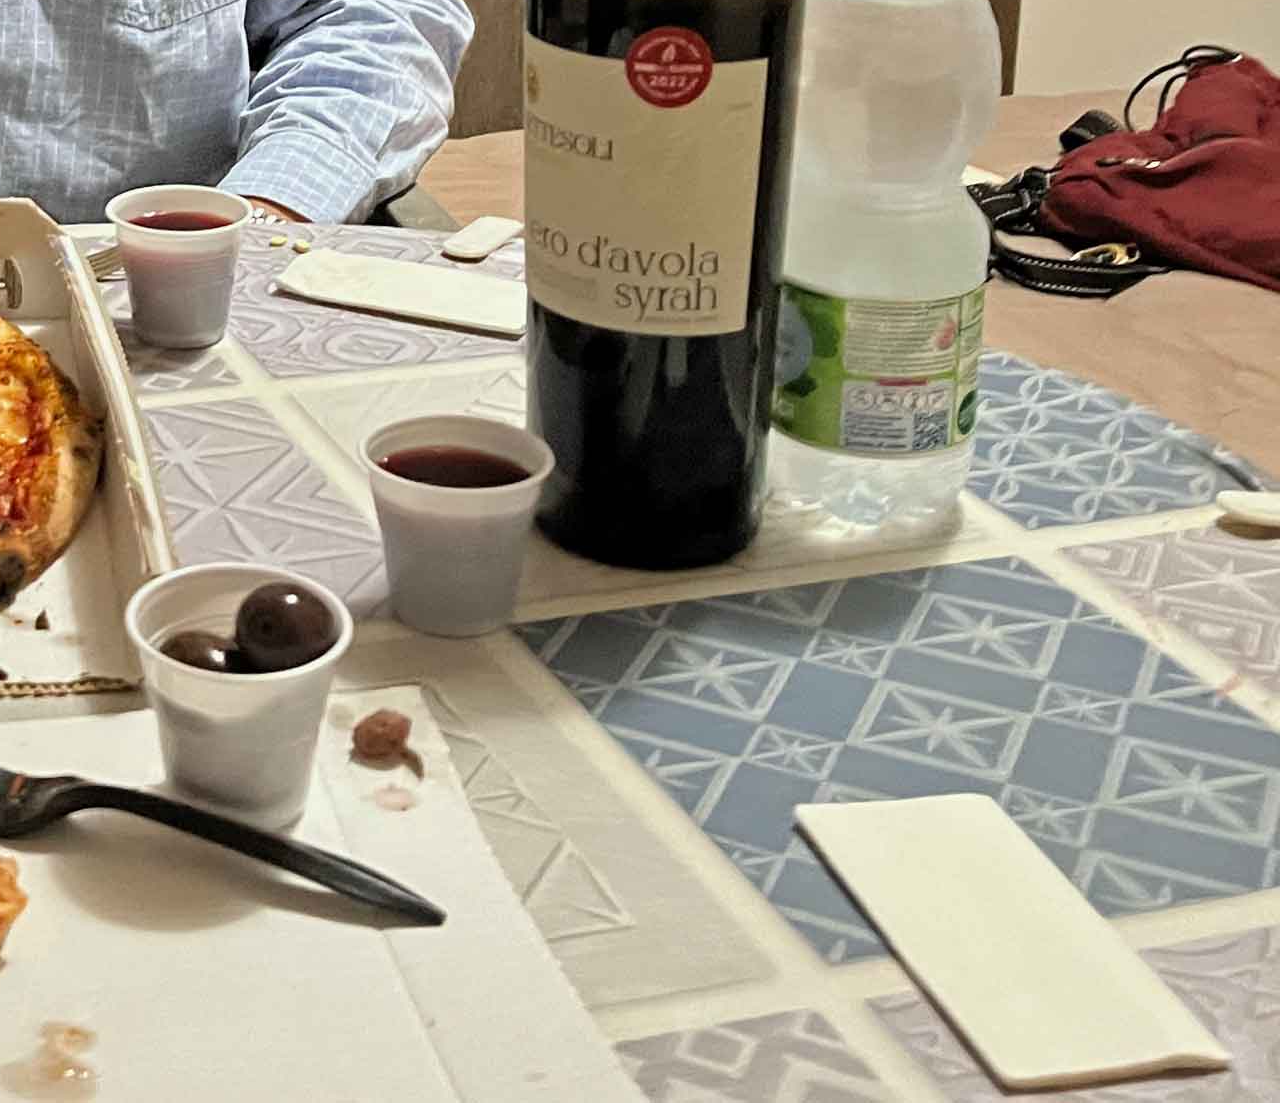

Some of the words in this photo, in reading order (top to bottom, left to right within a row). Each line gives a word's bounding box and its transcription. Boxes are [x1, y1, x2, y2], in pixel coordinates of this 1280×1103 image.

[527, 220, 568, 257] ero
[577, 235, 720, 277] d'avola
[615, 277, 718, 322] syrah
